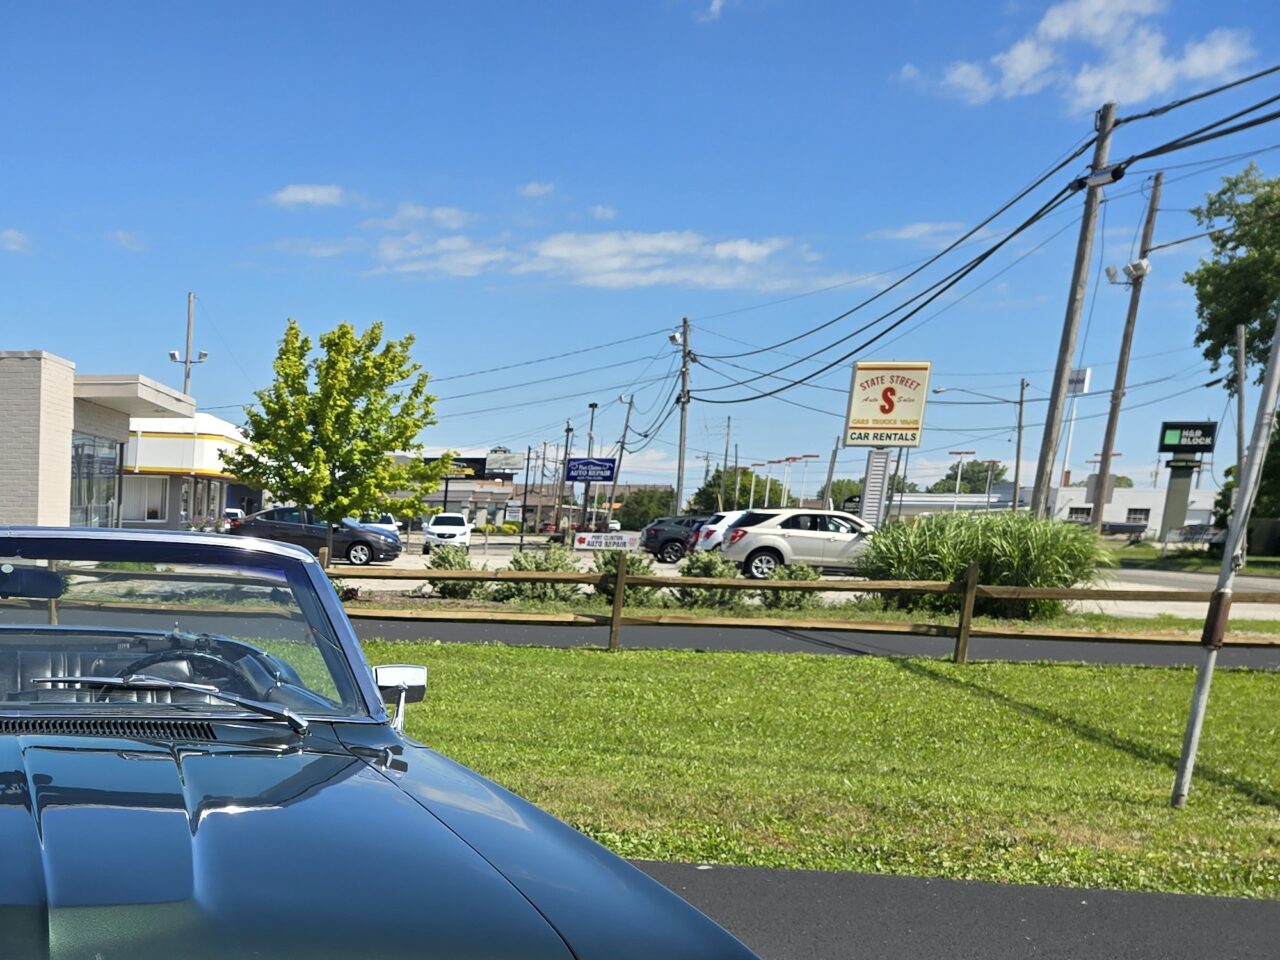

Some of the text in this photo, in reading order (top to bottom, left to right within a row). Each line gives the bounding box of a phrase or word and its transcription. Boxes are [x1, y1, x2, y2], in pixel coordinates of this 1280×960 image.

[860, 374, 920, 391] STATE STREET
[850, 432, 917, 441] CAR RENTALS
[1181, 437, 1212, 445] BLOCK
